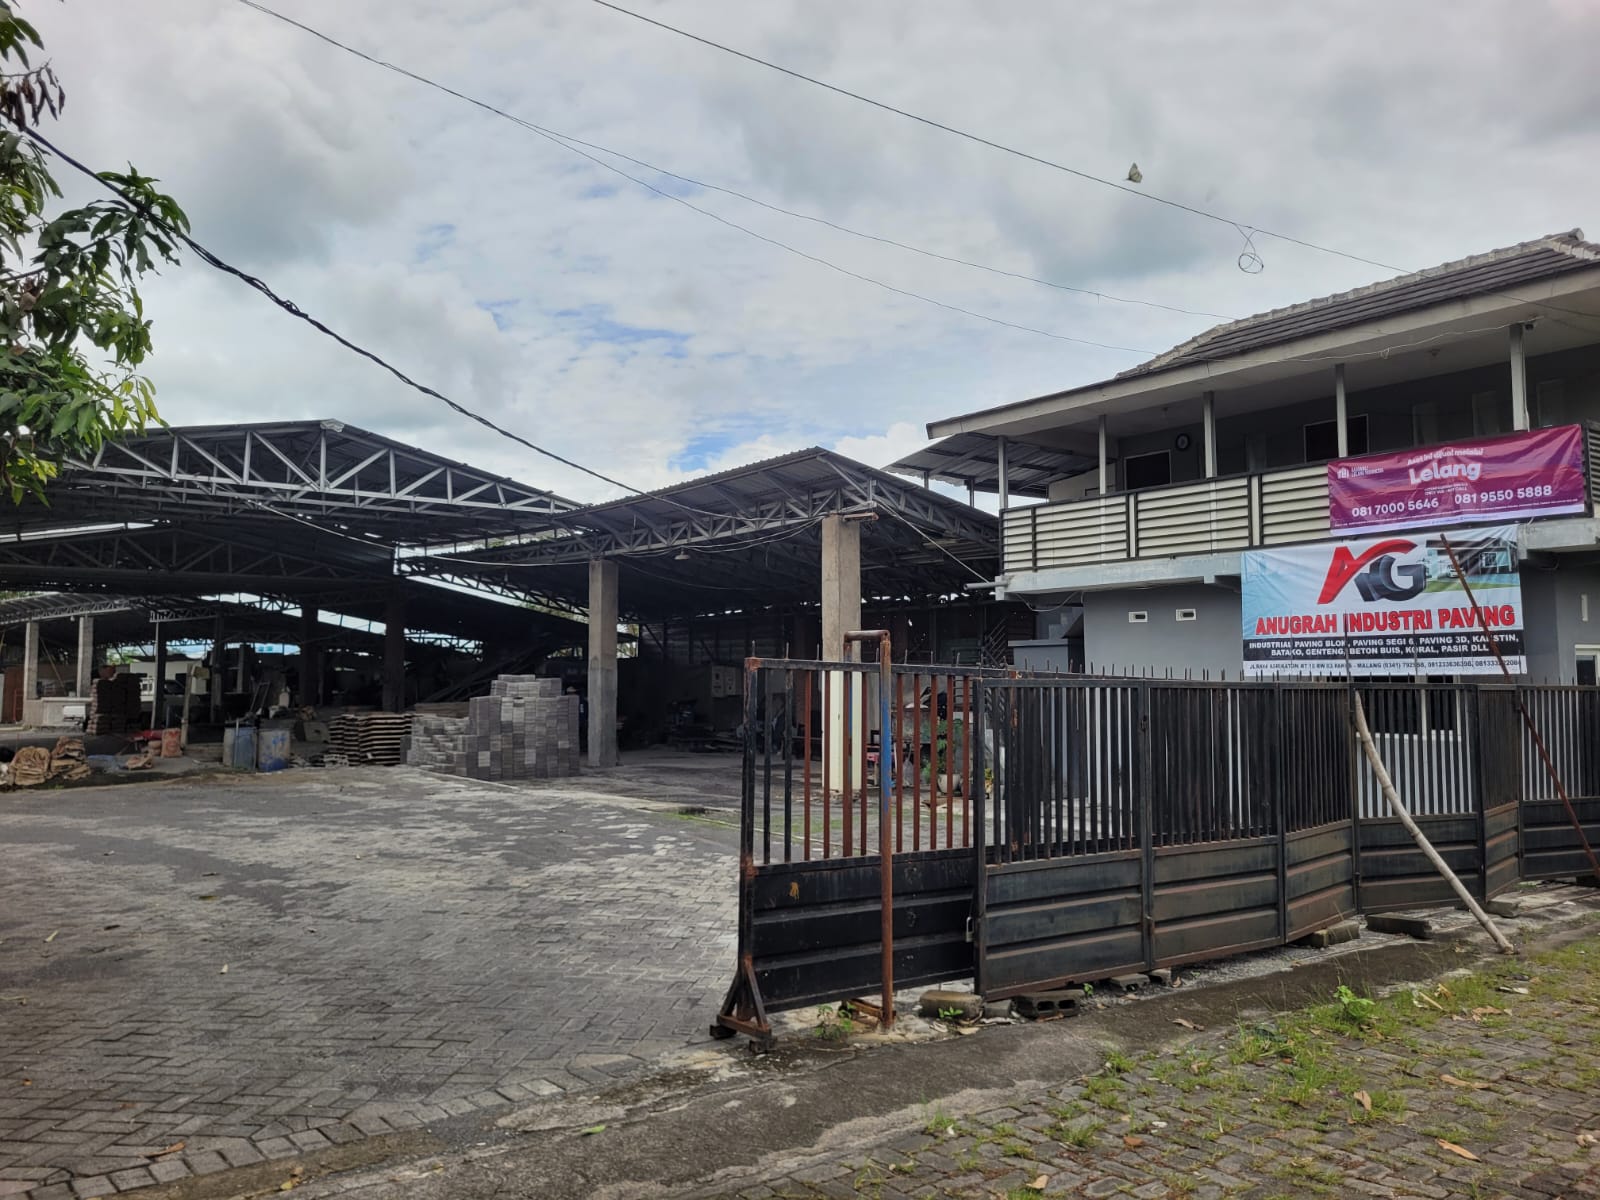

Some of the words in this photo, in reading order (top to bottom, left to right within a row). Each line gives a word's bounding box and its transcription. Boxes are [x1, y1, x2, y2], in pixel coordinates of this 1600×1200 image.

[1408, 462, 1481, 485] Lelang
[1455, 493, 1477, 505] 081
[1480, 489, 1513, 502] 9550
[1517, 485, 1552, 499] 5888
[1352, 506, 1372, 517] 081
[1375, 502, 1405, 515] 7000
[1407, 497, 1439, 511] 5646
[1255, 613, 1338, 635] ANUGRAH
[1343, 610, 1433, 633] INDUSTRI
[1437, 604, 1515, 629] PAVING
[1249, 641, 1291, 649] INDUSTRIAL
[1294, 640, 1323, 649] PAVING
[1353, 638, 1384, 647] PAVING
[1386, 637, 1407, 646] SEGI
[1419, 636, 1453, 645] PAVING
[1455, 635, 1469, 644] 3D,
[1271, 648, 1304, 657] BATAKO,
[1305, 647, 1346, 656] GENTENG,
[1349, 646, 1379, 656] BETON
[1380, 645, 1403, 655] BUIS,
[1405, 645, 1439, 655] KORAL,
[1441, 644, 1468, 653] PASIR
[1471, 643, 1489, 652] DLL
